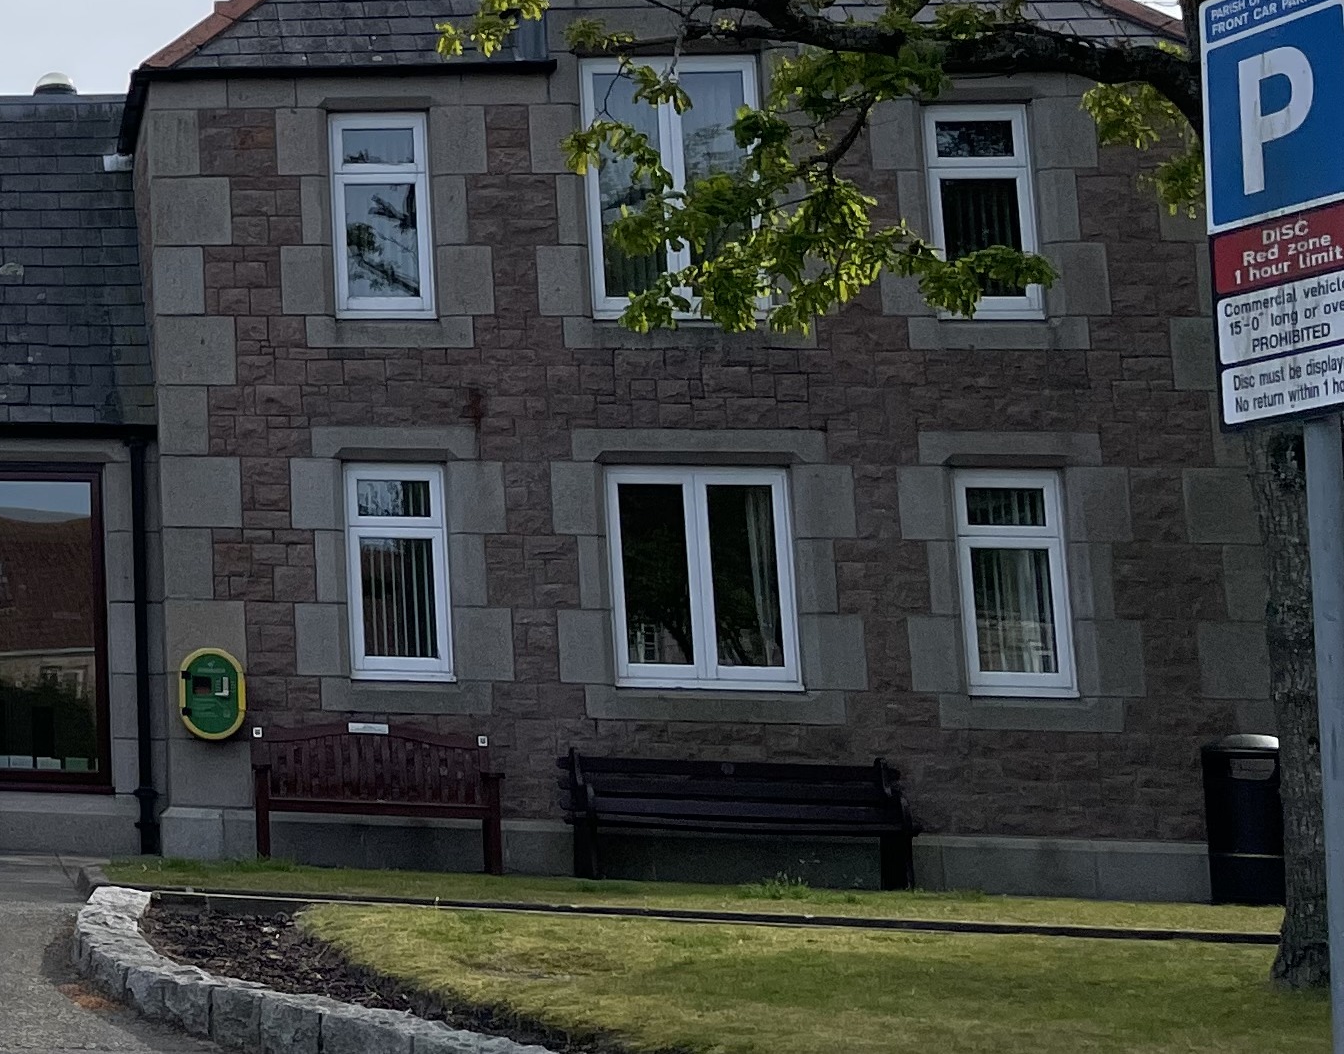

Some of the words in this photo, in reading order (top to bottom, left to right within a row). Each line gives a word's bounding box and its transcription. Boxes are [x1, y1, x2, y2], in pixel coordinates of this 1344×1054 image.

[1212, 12, 1249, 35] FRONT
[1253, 2, 1278, 20] CAR
[1238, 46, 1314, 196] P
[1262, 220, 1309, 245] DISC
[1235, 270, 1241, 285] 1
[1249, 261, 1291, 282] hour
[1299, 245, 1344, 268] limit
[1243, 244, 1279, 266] Red
[1287, 234, 1331, 256] zone
[1224, 286, 1297, 317] Commercial
[1271, 310, 1298, 327] long
[1304, 305, 1318, 319] or
[1252, 323, 1331, 352] PROHIBITED
[1233, 374, 1255, 391] Disc
[1259, 367, 1285, 386] must
[1289, 364, 1301, 380] be
[1235, 396, 1249, 413] No
[1253, 392, 1284, 410] return
[1288, 381, 1320, 402] within
[1323, 378, 1329, 395] 1
